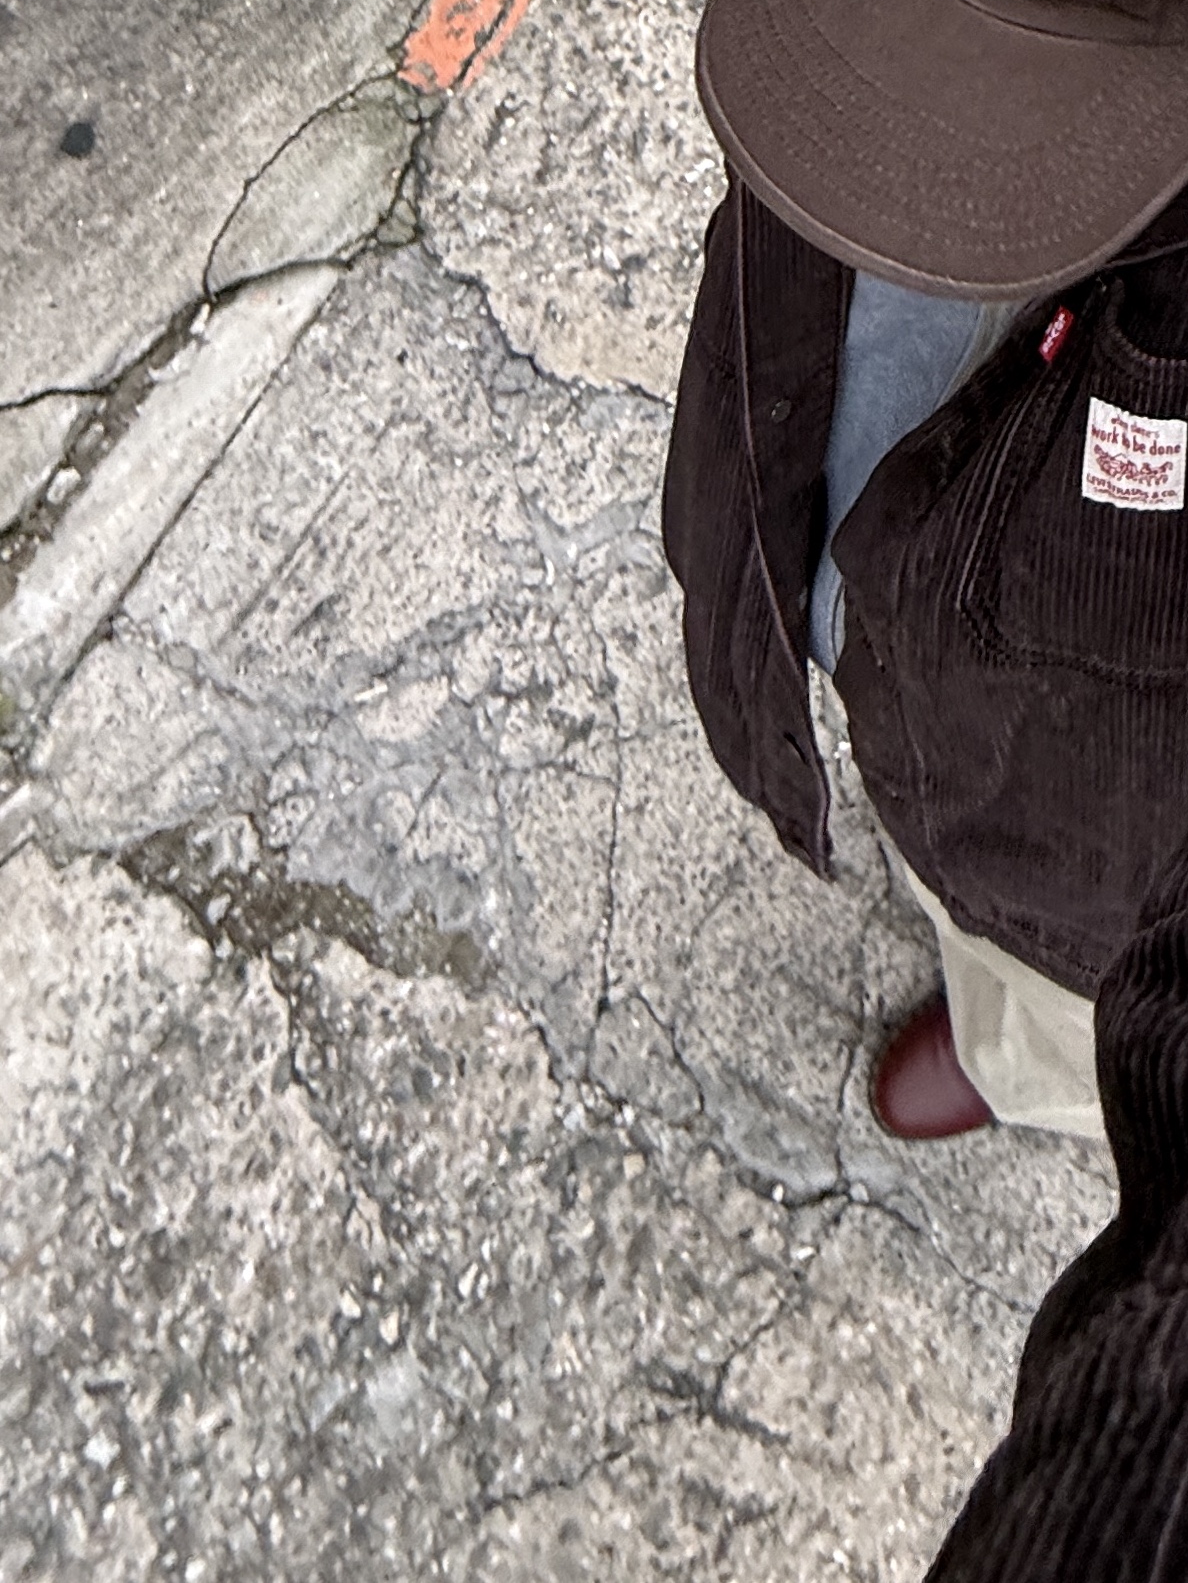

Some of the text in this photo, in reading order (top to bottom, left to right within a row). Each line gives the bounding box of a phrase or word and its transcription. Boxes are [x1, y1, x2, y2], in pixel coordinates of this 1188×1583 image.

[1091, 424, 1119, 444] work
[1133, 435, 1146, 455] be
[1149, 439, 1181, 456] done
